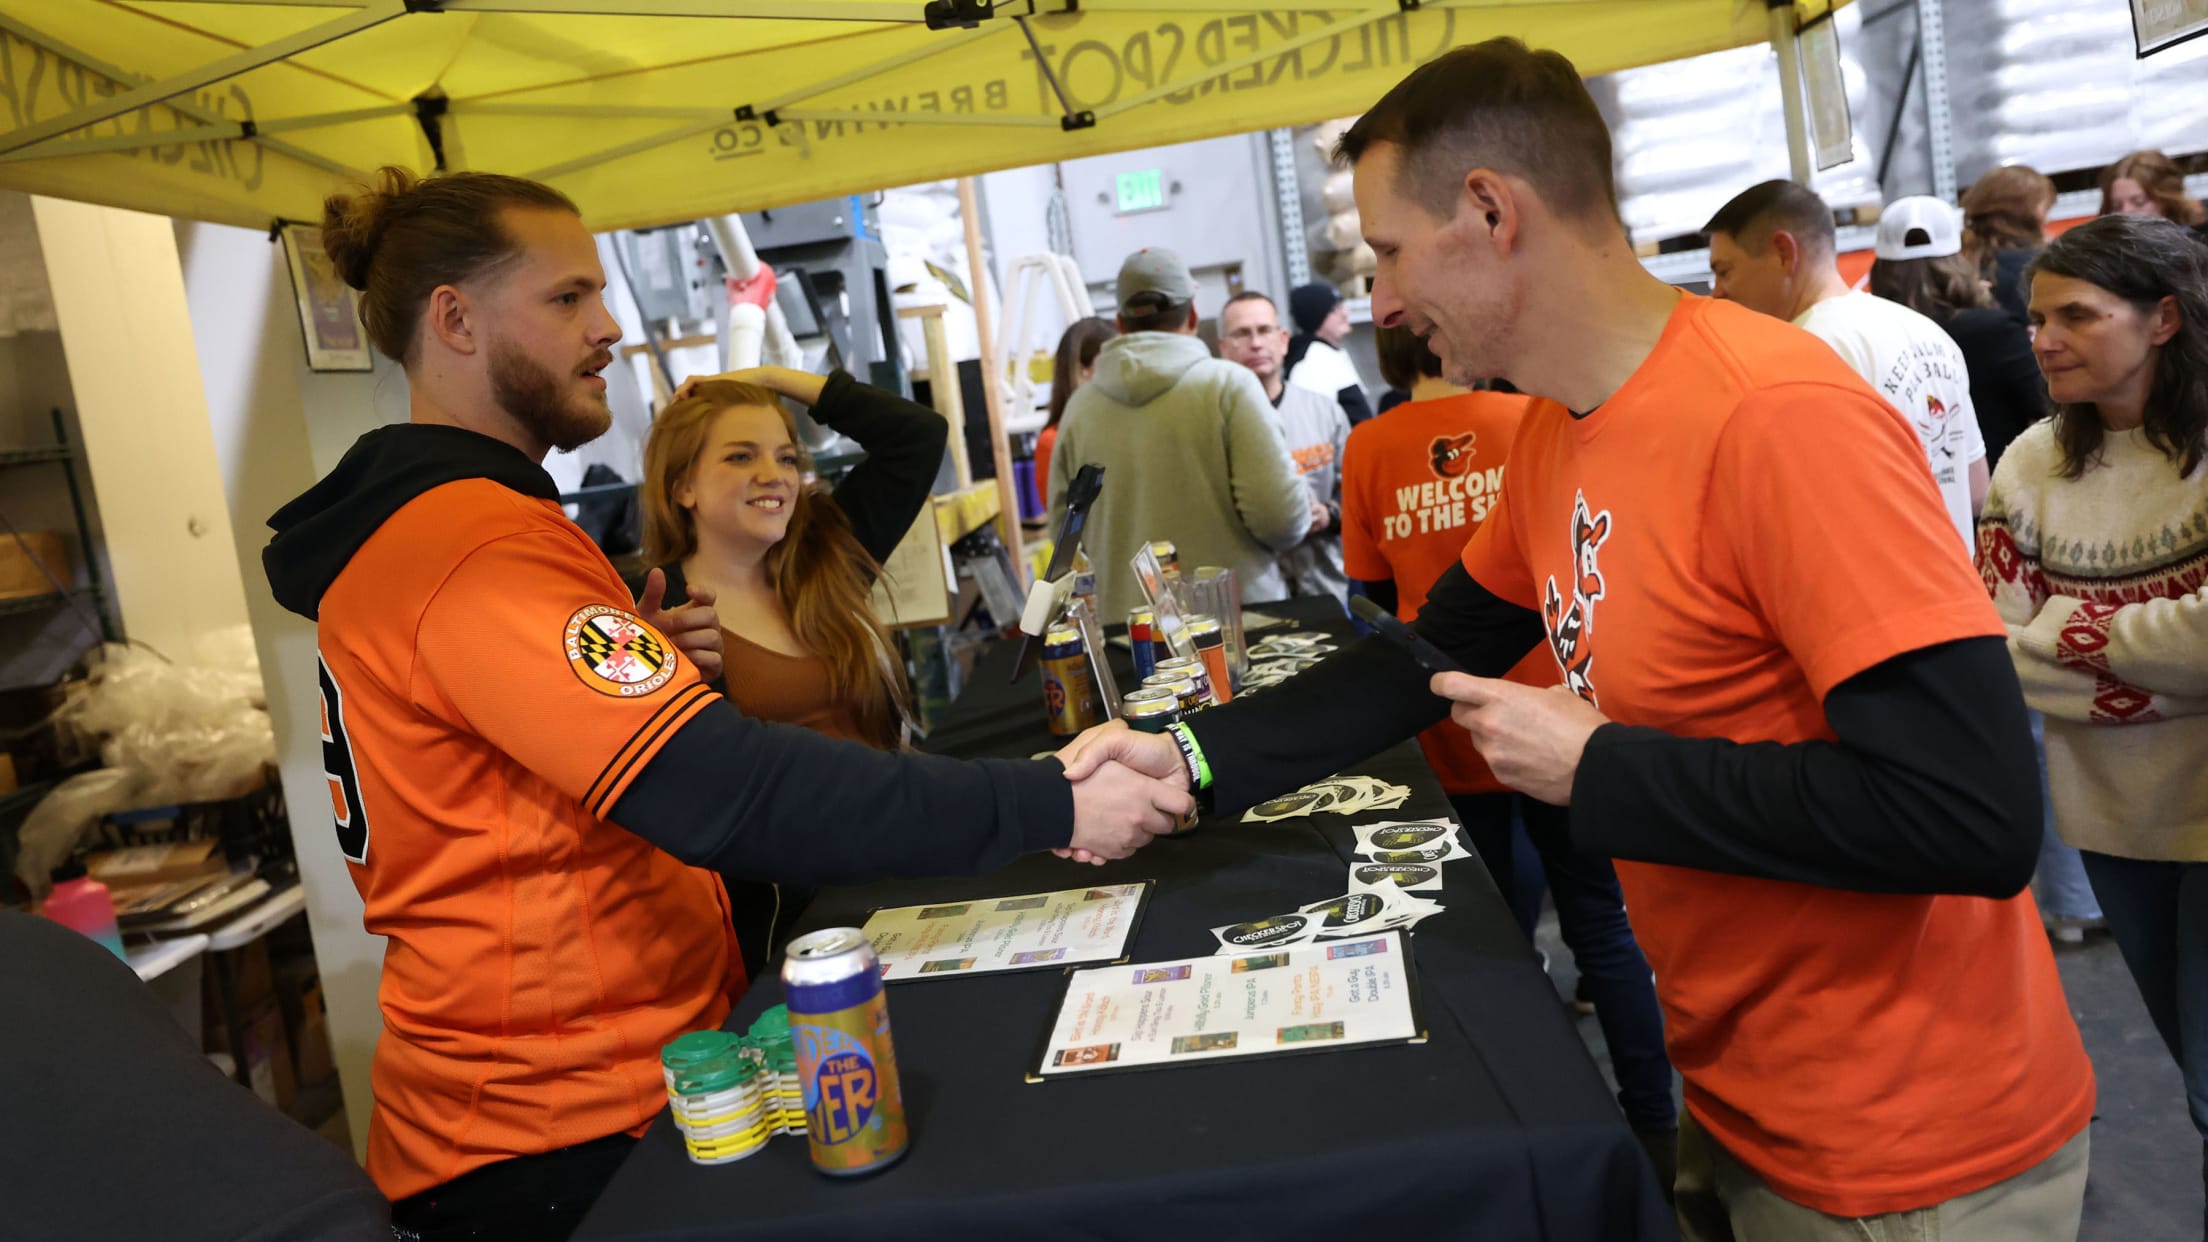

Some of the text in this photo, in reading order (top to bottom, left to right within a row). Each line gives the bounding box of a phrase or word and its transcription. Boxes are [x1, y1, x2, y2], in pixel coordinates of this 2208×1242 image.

[1116, 168, 1163, 211] EXIT
[1396, 465, 1505, 513] WELCOM
[1384, 513, 1412, 541] TO
[1417, 501, 1466, 534] THE
[566, 605, 636, 662] BALTIMORE
[619, 652, 676, 695] ORIOLES
[1232, 920, 1303, 944] CHECKERSPOT
[1363, 977, 1379, 1002] Double
[826, 1055, 862, 1074] THE
